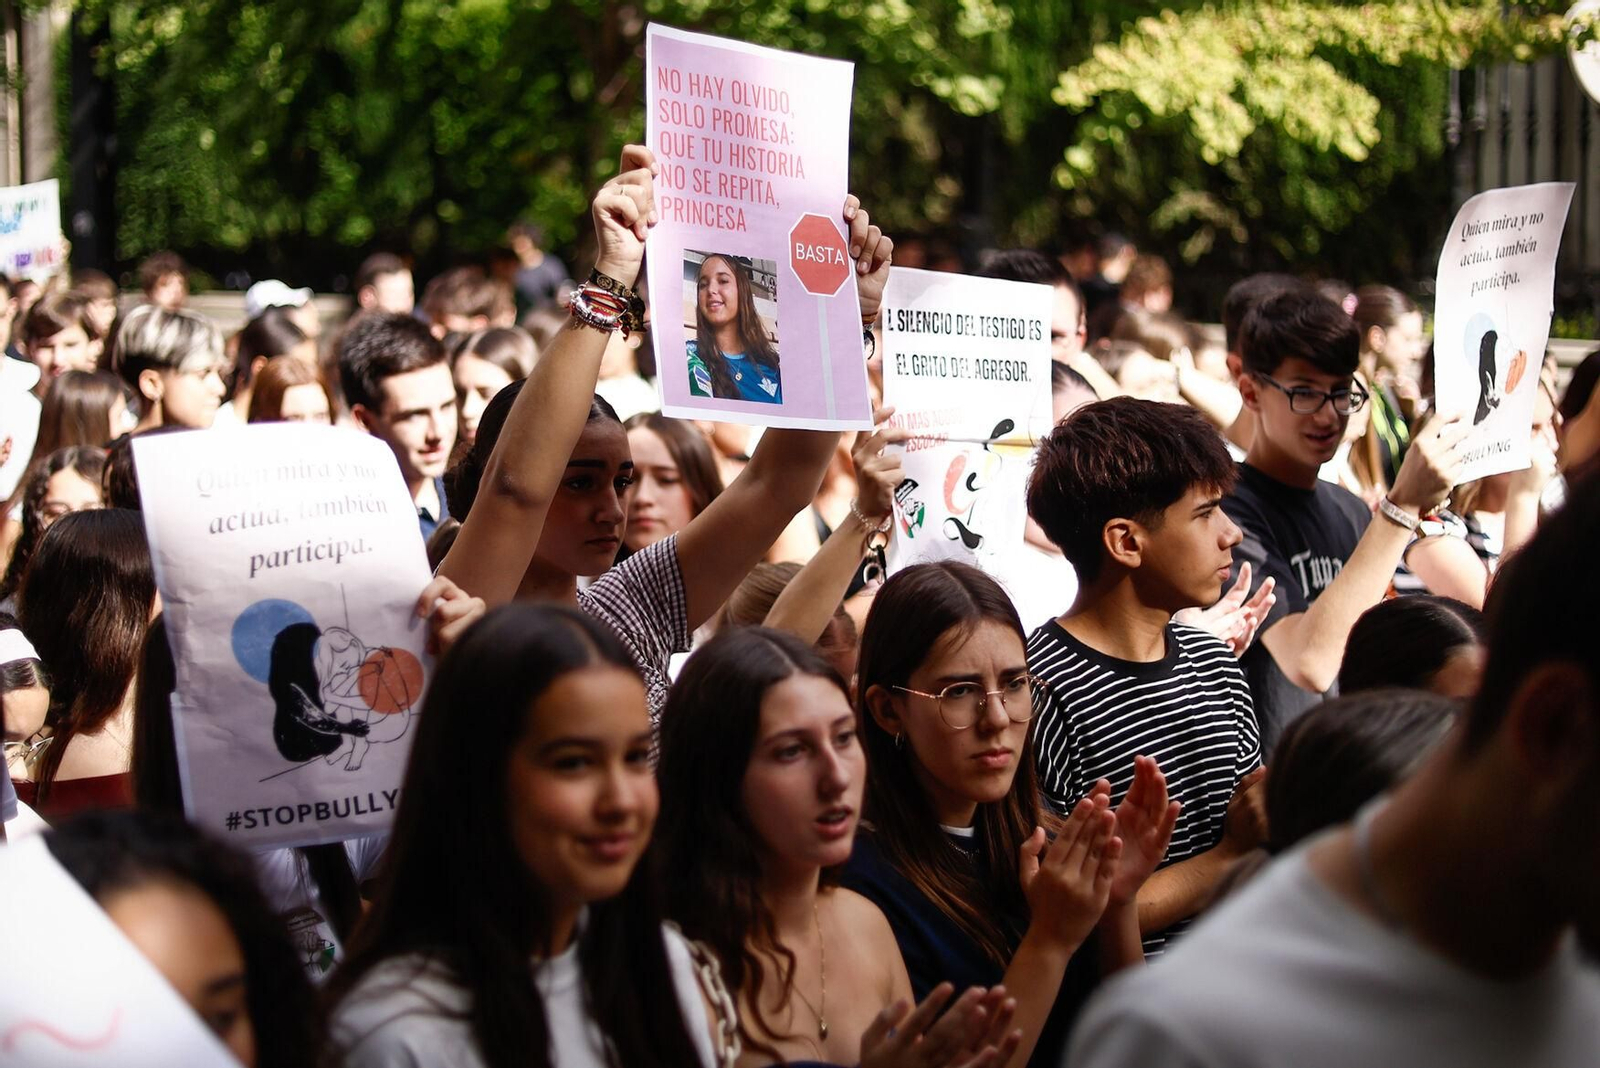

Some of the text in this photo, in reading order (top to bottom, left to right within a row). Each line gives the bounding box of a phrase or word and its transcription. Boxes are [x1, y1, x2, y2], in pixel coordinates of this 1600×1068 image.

[658, 66, 795, 118] NO HAY OLVIDO,
[659, 98, 795, 145] SOLO PROMESA:
[660, 131, 805, 179] QUE TU HISTORIA
[661, 163, 780, 209] NO SE REPITA,
[661, 196, 747, 232] PRINCESA
[1461, 212, 1544, 242] Quien mira y no
[796, 242, 846, 266] BASTA
[1471, 271, 1520, 297] participa.
[897, 309, 952, 335] SILENCIO
[956, 314, 976, 337] DEL
[980, 316, 1025, 340] TESTIGO
[1029, 319, 1042, 341] ES
[896, 353, 1032, 382] EL GRITO DEL AGRESOR.
[907, 411, 930, 431] MAS
[277, 458, 331, 484] mira
[249, 535, 374, 580] participa.
[225, 788, 399, 831] #STOPBULLY
